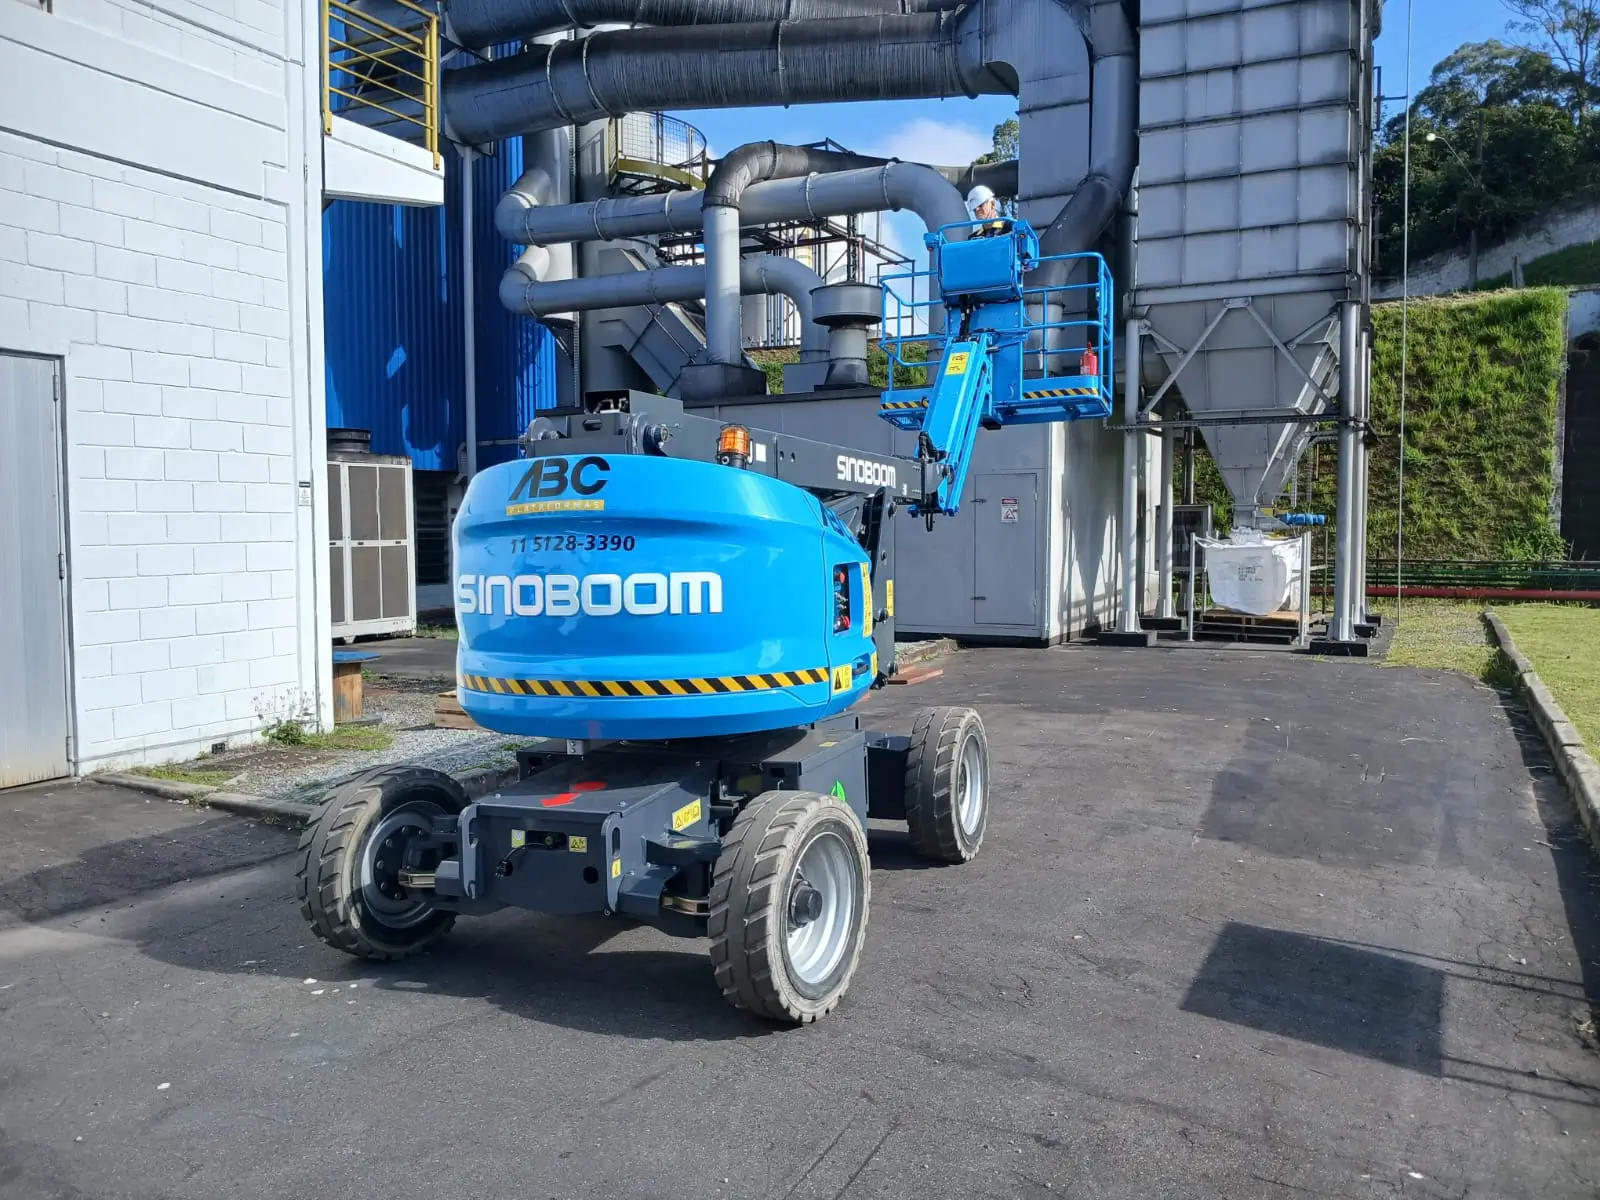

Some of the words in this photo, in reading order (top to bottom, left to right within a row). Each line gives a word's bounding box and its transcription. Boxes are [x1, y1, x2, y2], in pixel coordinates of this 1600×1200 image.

[508, 456, 611, 501] ABC
[836, 454, 896, 489] SINOBOOM
[511, 537, 527, 554] 11
[532, 534, 636, 552] 5128-3390
[457, 571, 722, 616] SINOBOOM
